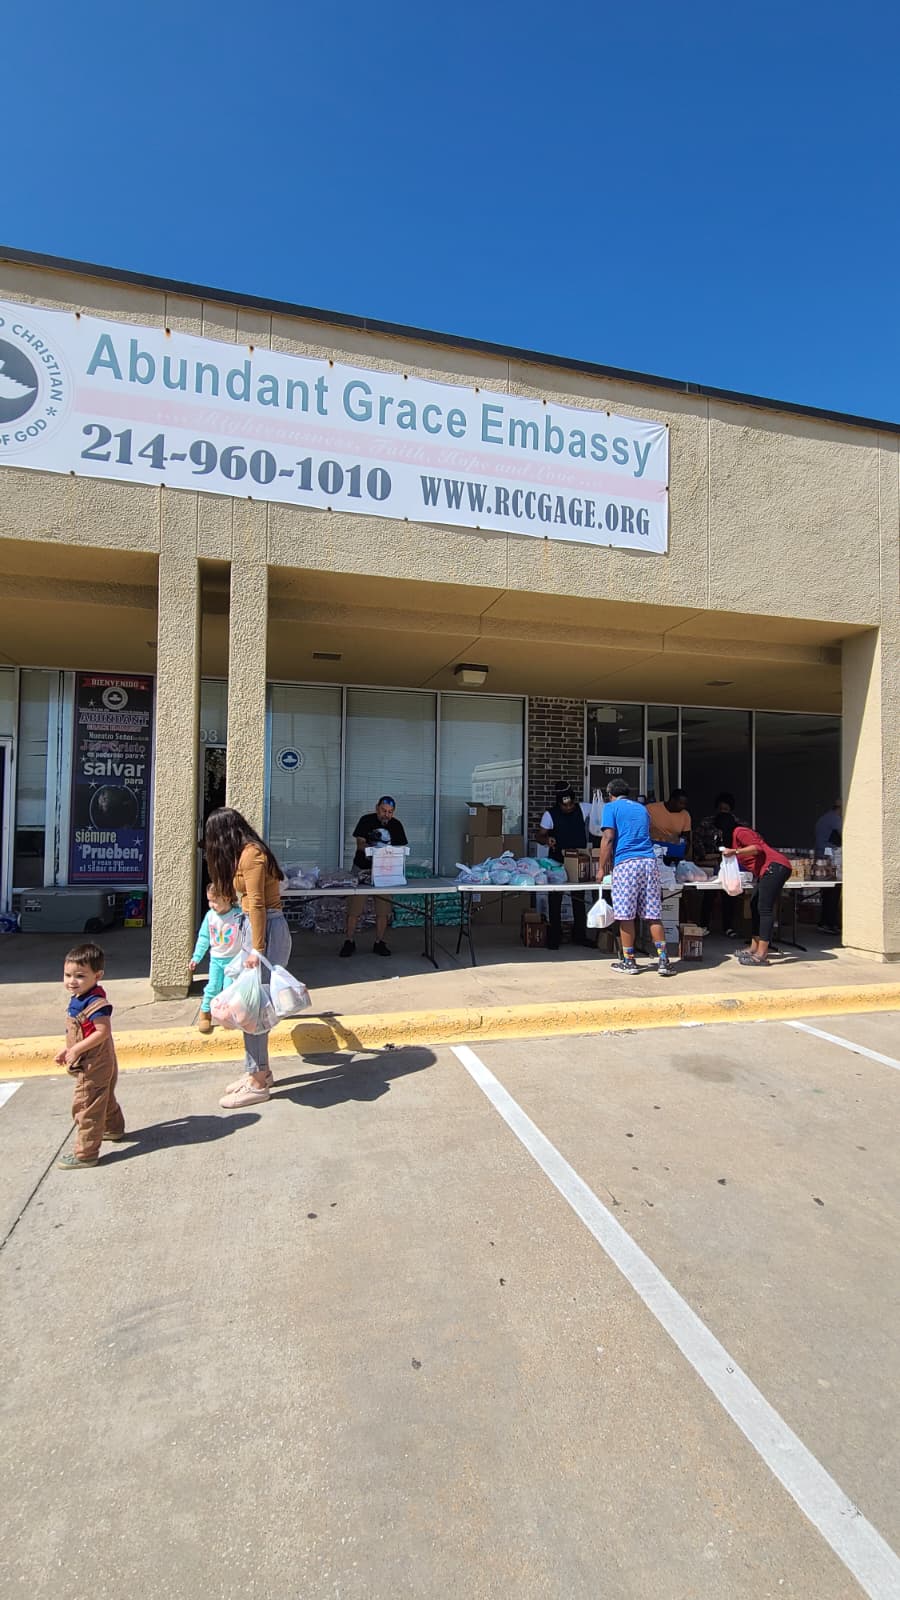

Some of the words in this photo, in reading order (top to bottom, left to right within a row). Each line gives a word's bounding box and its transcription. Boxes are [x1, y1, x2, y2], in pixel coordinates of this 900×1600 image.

[12, 323, 63, 402] CHRISTIAN
[86, 333, 328, 416] Abundant
[342, 380, 467, 439] Grace
[481, 403, 651, 478] Embassy
[14, 418, 48, 443] GOD
[495, 457, 535, 474] and
[81, 423, 392, 501] 214-960-1010
[420, 474, 651, 536] WWW.RCCGAGE.ORG
[91, 678, 140, 688] BIENVENIDO
[89, 731, 114, 740] Nuestro
[83, 759, 146, 777] salvar
[75, 829, 117, 845] siempre
[82, 843, 144, 862] Prueben,
